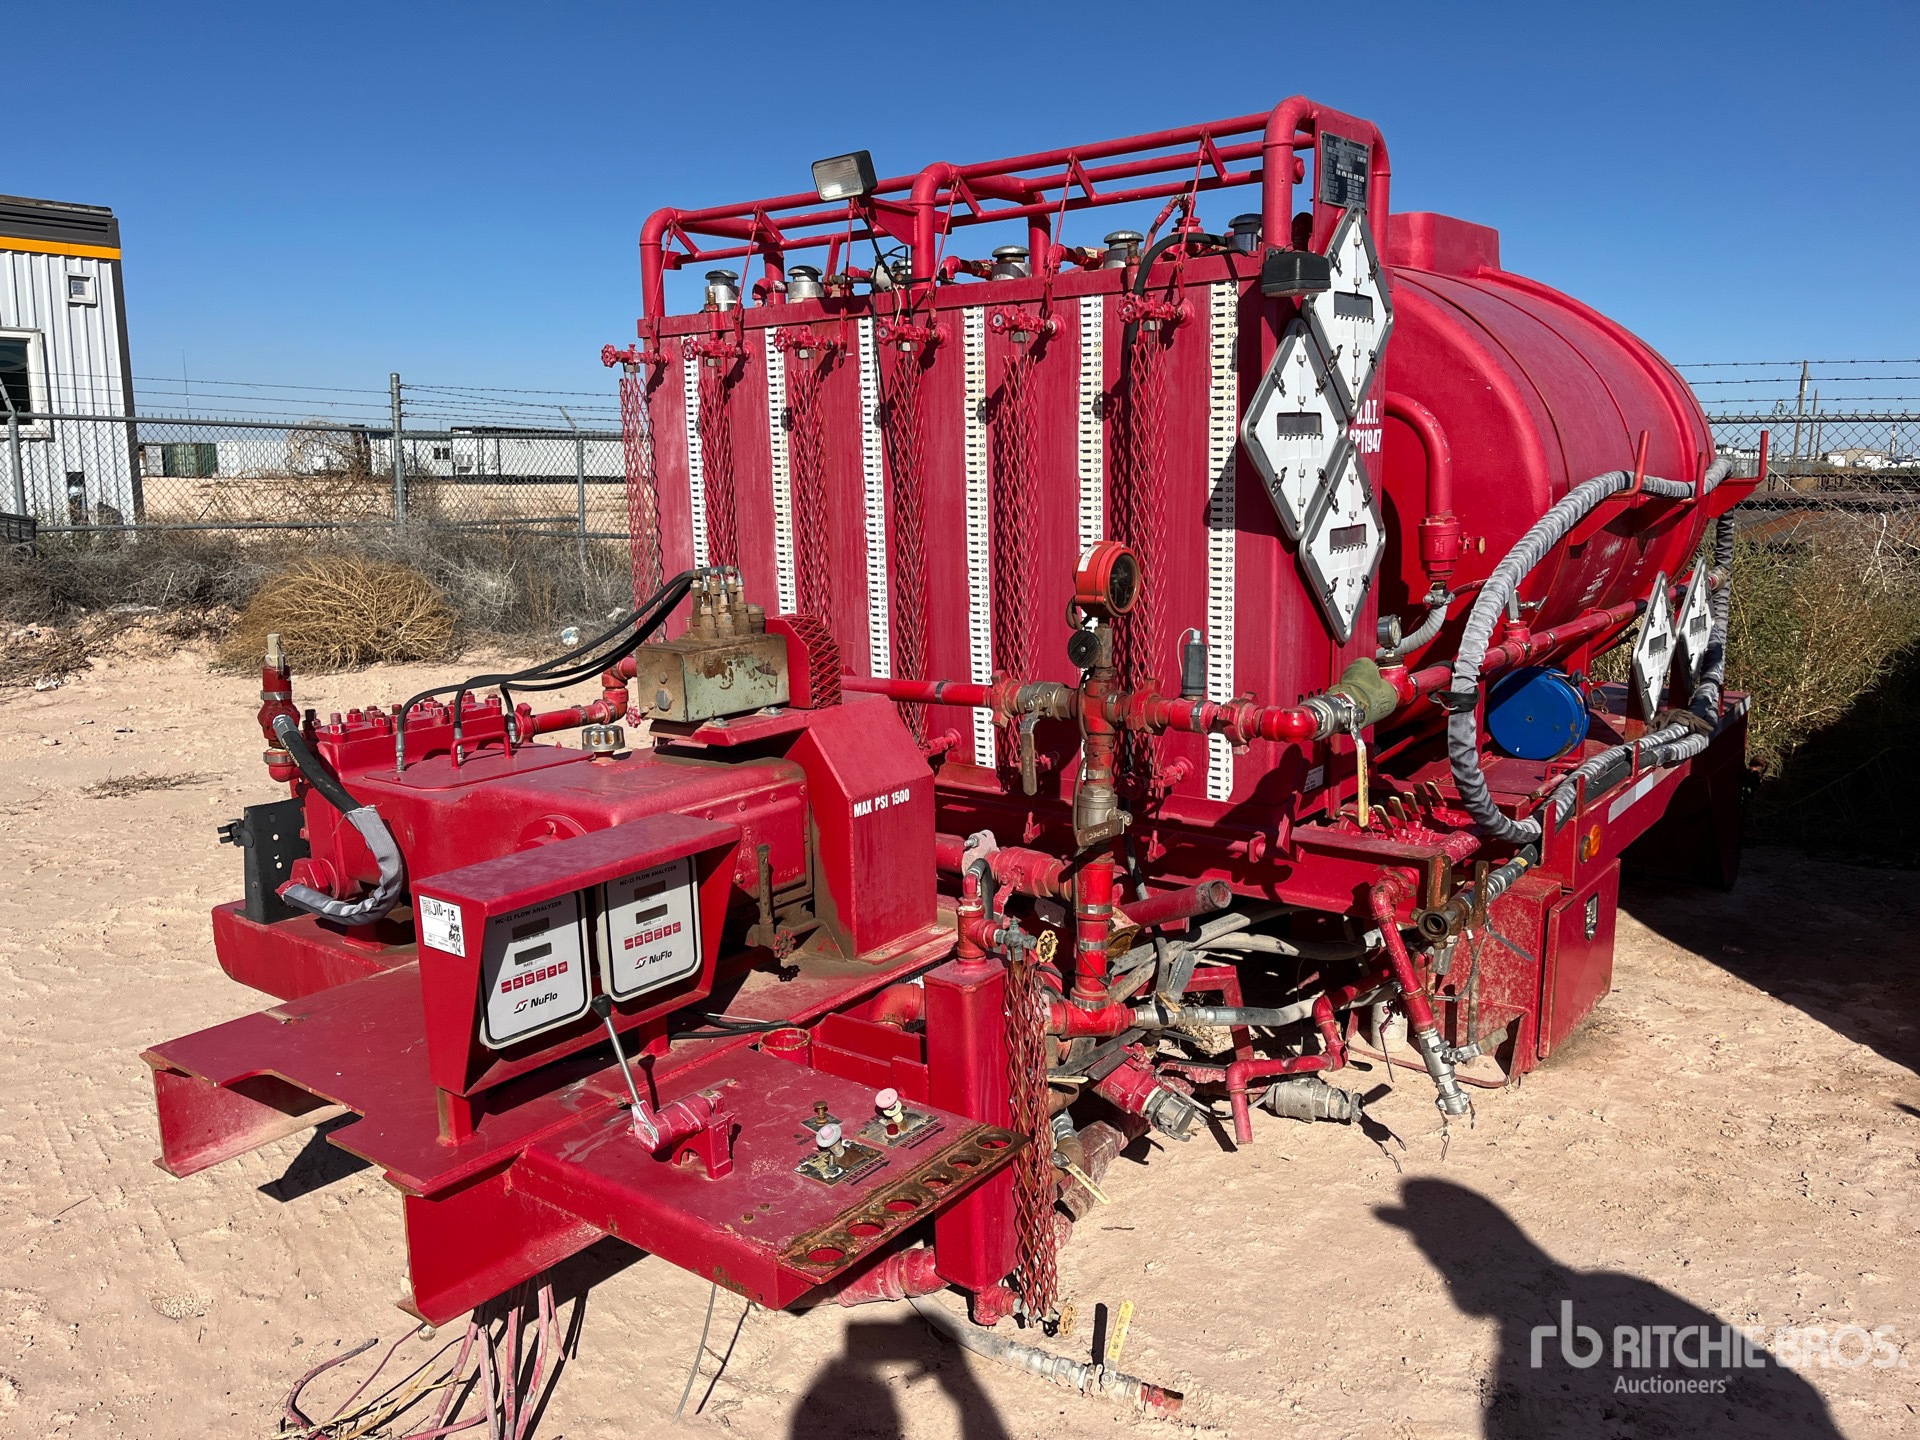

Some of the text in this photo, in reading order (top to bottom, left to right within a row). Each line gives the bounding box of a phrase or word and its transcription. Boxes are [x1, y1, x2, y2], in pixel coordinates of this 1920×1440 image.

[854, 788, 910, 818] MAX PSI 1500
[636, 873, 650, 881] FLOW
[651, 865, 677, 876] ANALYZER
[495, 901, 562, 925] MC-II FLOW ANALYZER
[649, 950, 672, 965] NuFlo
[530, 992, 558, 1008] NuFlo
[900, 1122, 942, 1148] DISCHARGE
